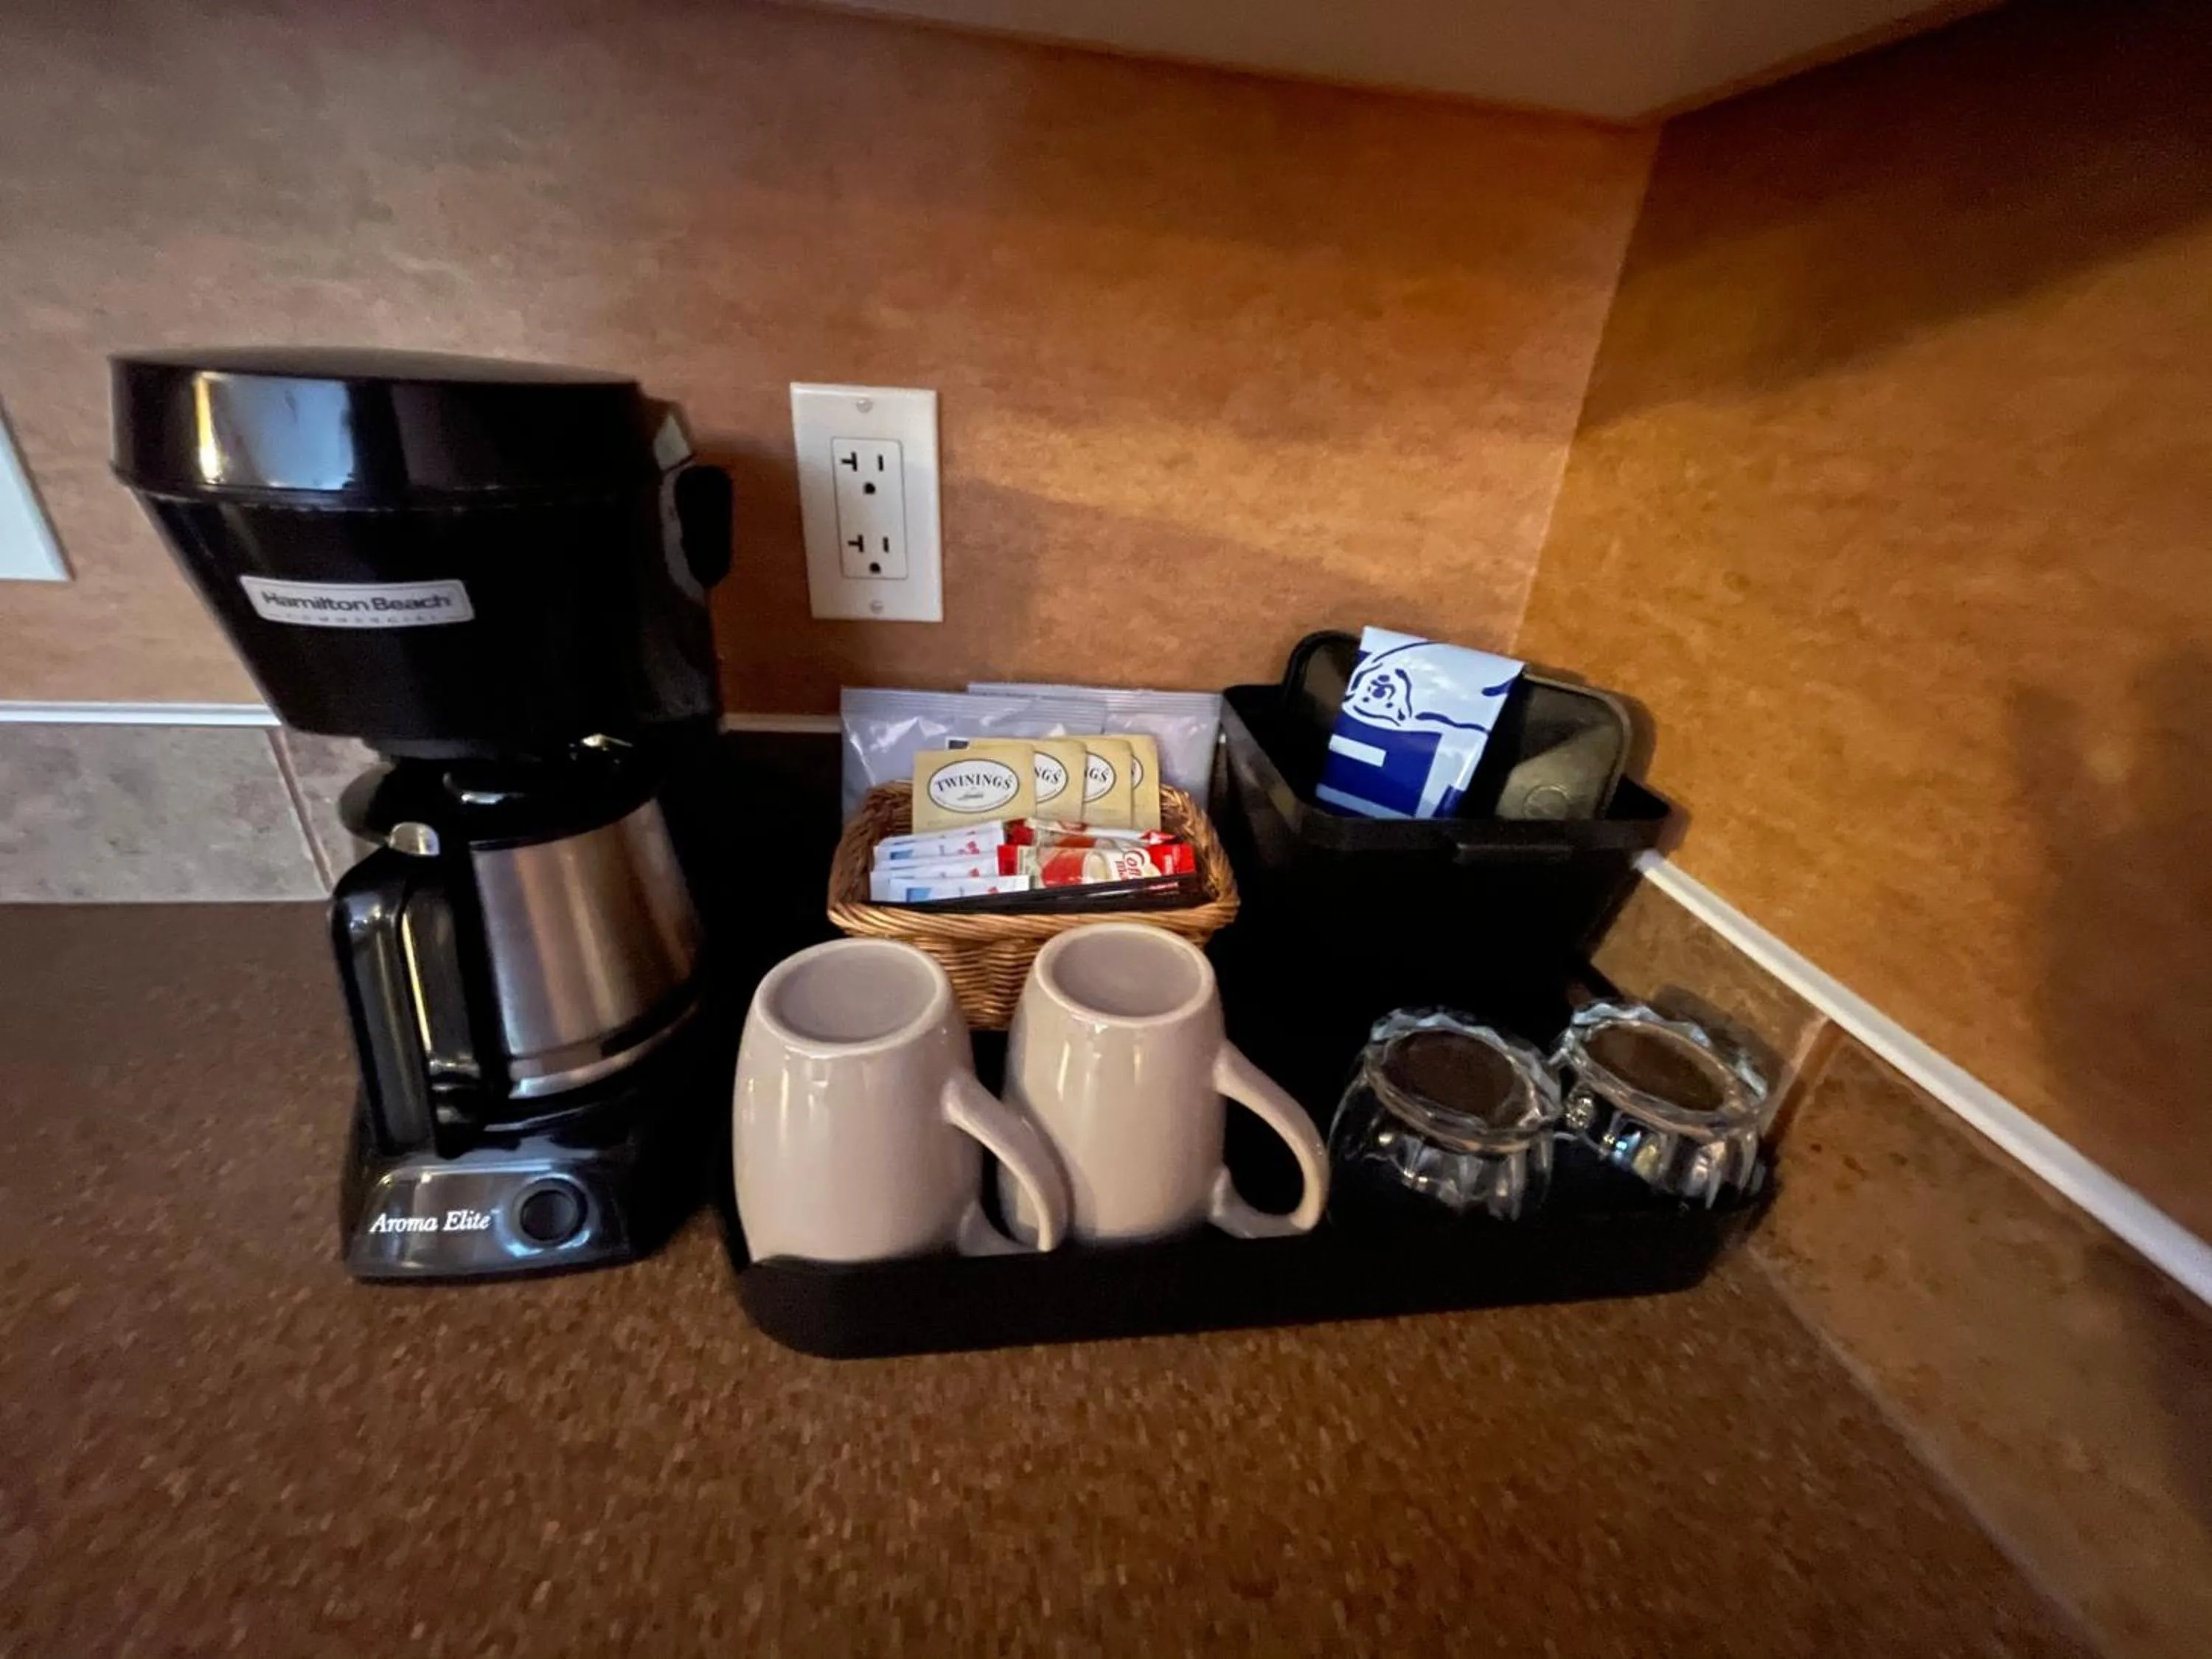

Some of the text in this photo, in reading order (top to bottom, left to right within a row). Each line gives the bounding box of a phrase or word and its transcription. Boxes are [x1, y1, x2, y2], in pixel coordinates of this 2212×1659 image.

[261, 591, 452, 612] Hamilton Beach
[934, 773, 1012, 791] TWININGS
[369, 1209, 491, 1234] Aroma Elite
